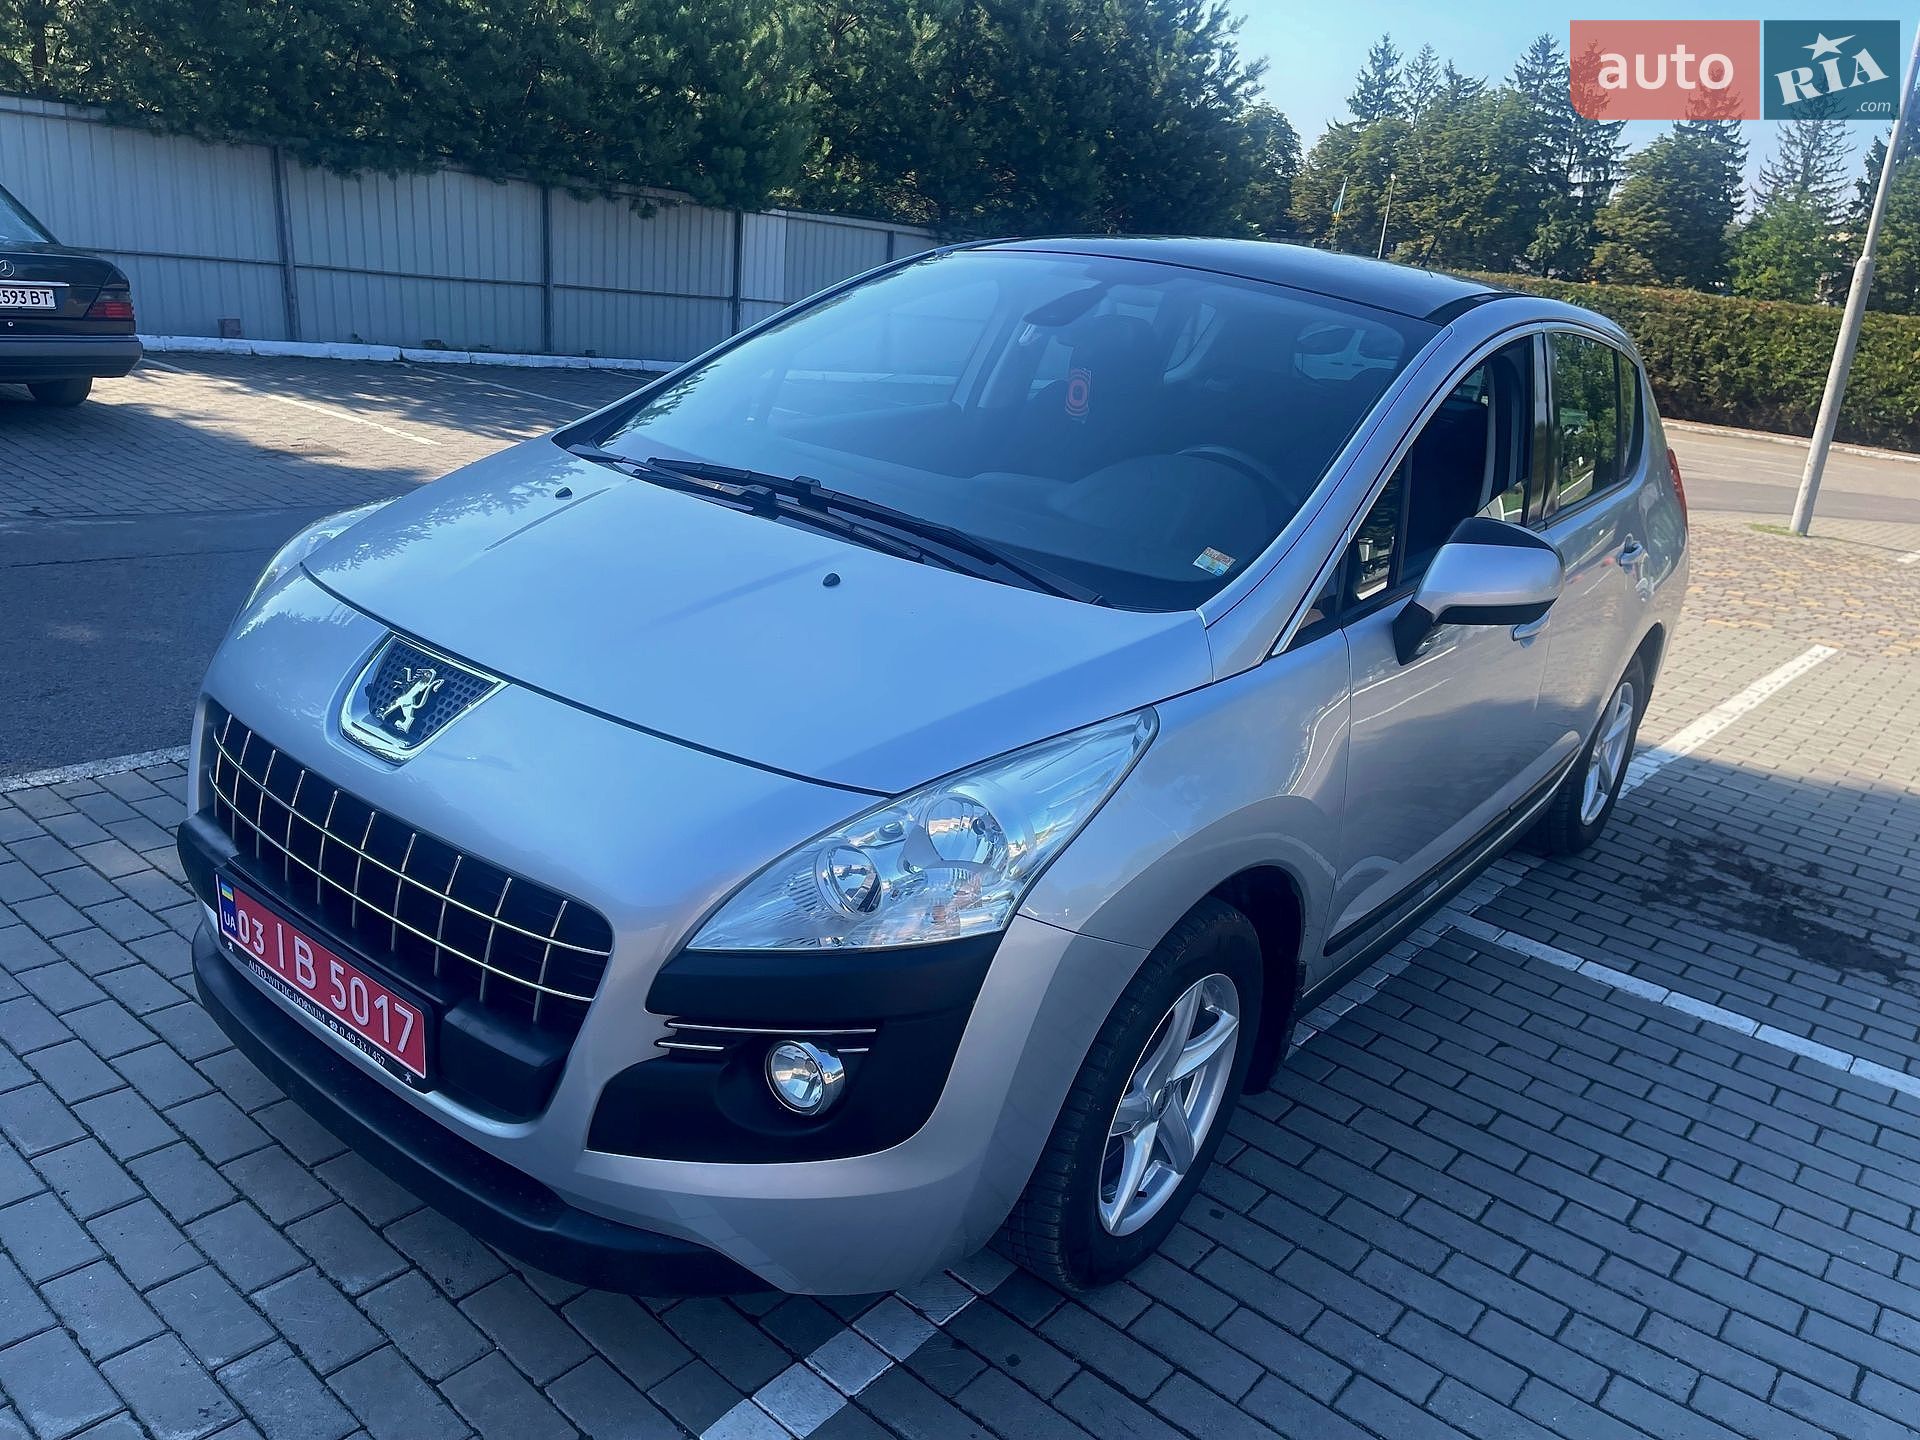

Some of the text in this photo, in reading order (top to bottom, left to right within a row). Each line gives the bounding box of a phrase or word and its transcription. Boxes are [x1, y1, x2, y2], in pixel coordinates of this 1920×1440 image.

[0, 290, 50, 305] 593 BT
[223, 911, 236, 931] UA
[238, 909, 265, 955] 03
[330, 959, 414, 1053] 5017
[371, 1051, 385, 1066] 457
